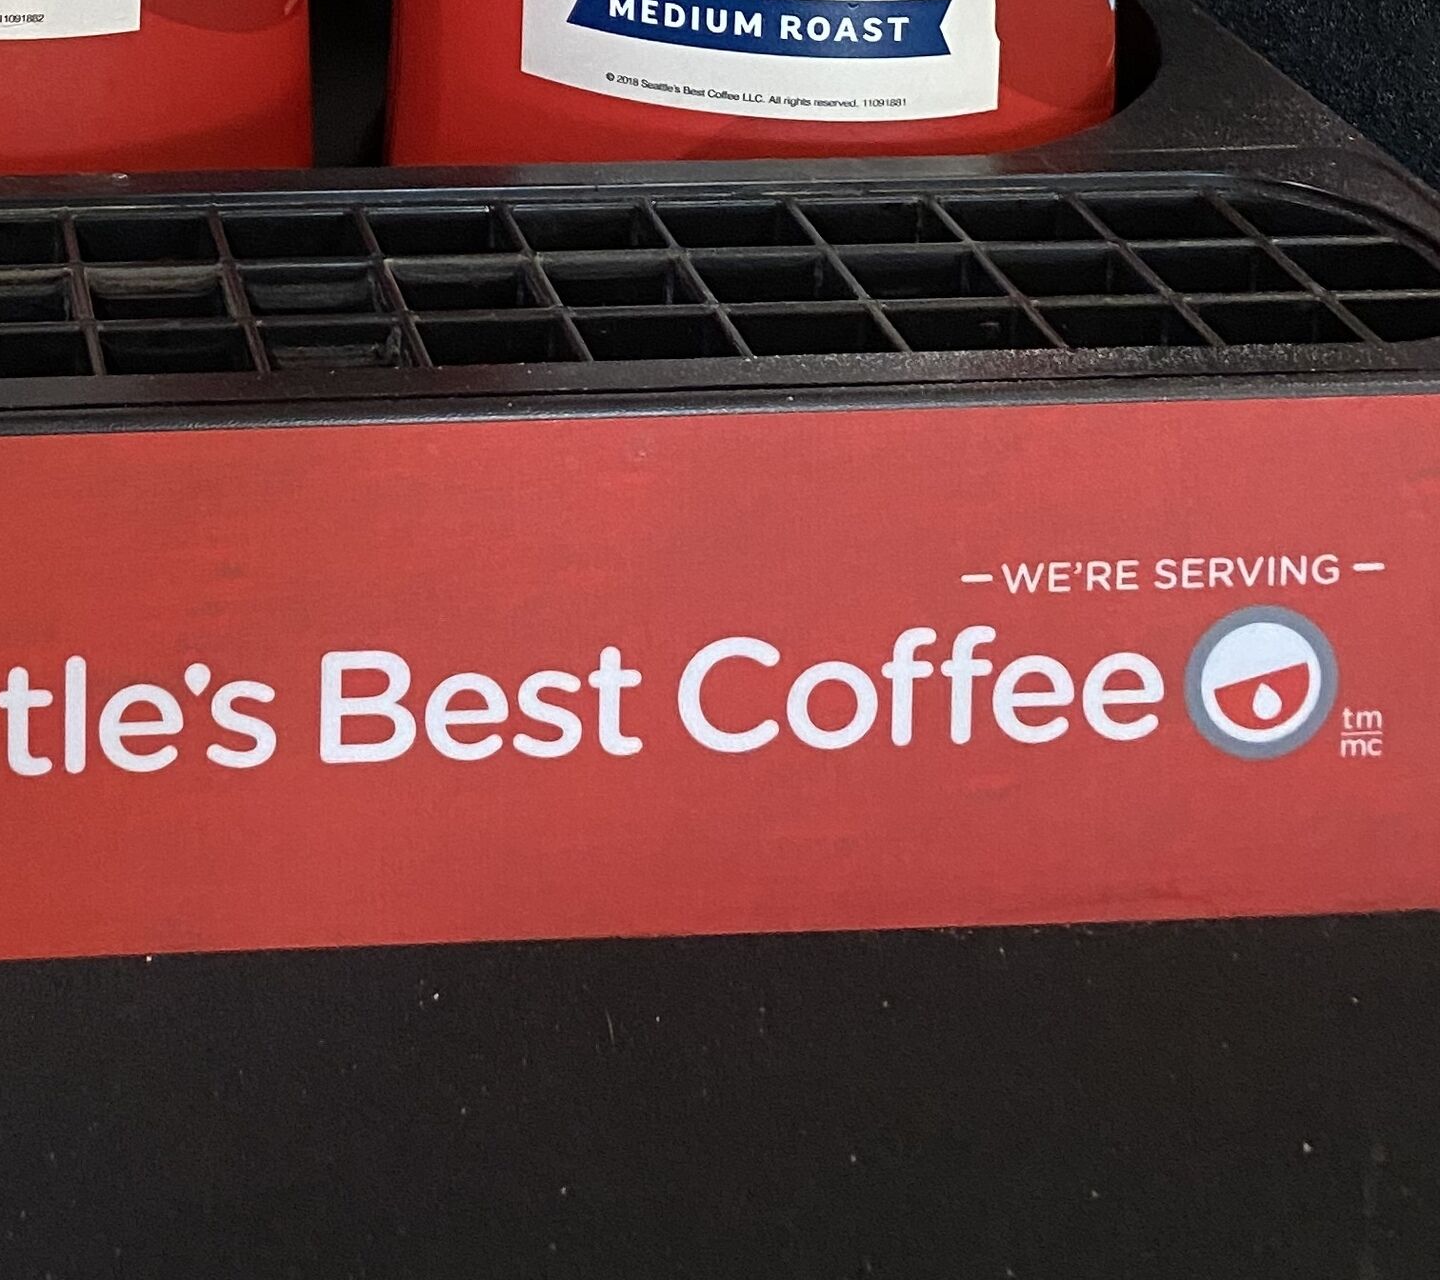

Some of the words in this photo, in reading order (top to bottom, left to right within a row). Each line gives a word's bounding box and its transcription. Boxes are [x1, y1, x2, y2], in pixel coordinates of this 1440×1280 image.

[780, 15, 910, 41] ROAST
[617, 74, 639, 87] 2018
[683, 85, 705, 97] Best
[707, 89, 740, 101] Coffee
[768, 95, 782, 105] All
[783, 97, 811, 108] rights
[1001, 560, 1140, 593] WE'RE
[1154, 554, 1341, 590] SERVING
[319, 645, 643, 764] Best
[677, 624, 1165, 754] Coffee
[1342, 707, 1383, 730] tm
[1340, 737, 1383, 757] mc
